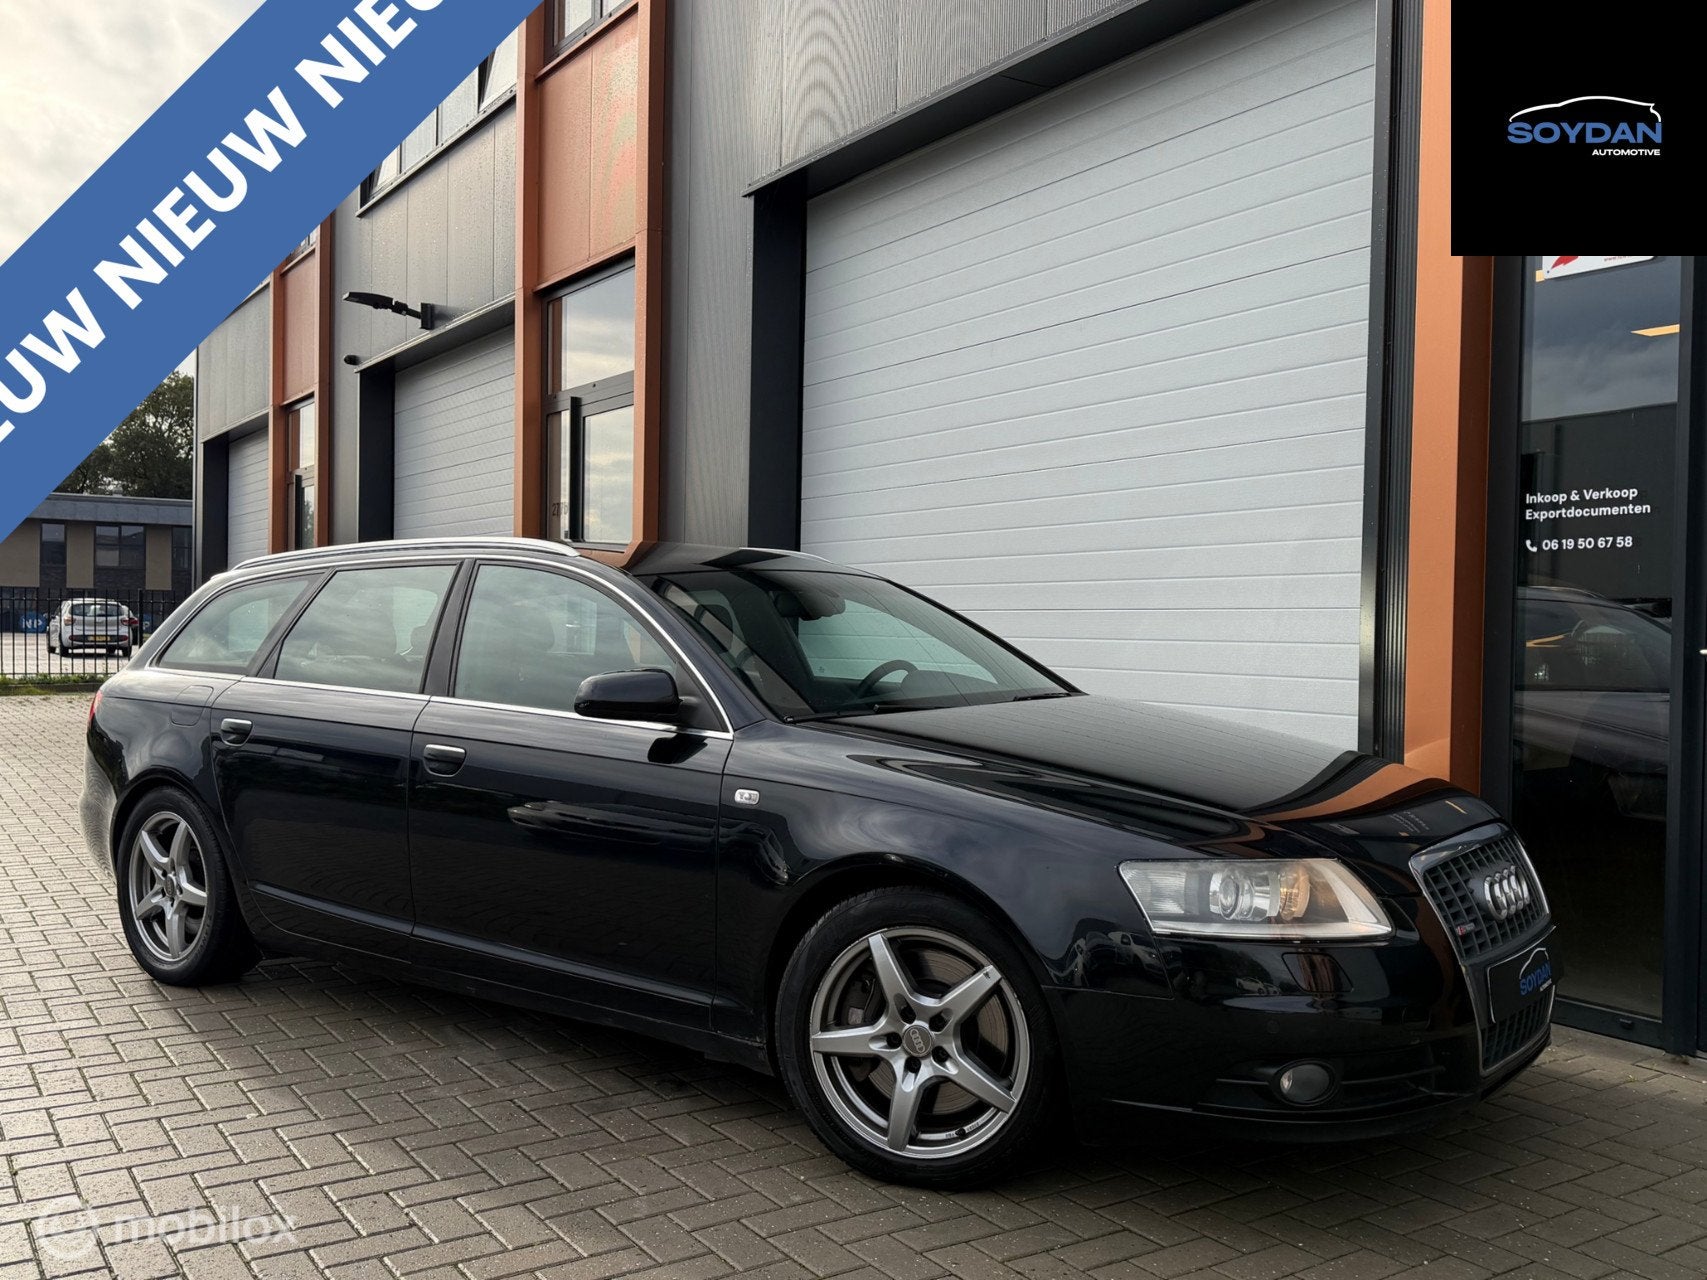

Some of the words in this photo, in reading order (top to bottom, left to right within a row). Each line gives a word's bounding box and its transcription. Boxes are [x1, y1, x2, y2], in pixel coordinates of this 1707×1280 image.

[1525, 492, 1567, 504] Inkoop
[1570, 490, 1580, 501] &
[1583, 487, 1638, 500] Verkoop
[1525, 504, 1650, 521] Exportdocumenten
[1542, 539, 1559, 550] 06
[1561, 539, 1575, 549] 19
[1577, 537, 1595, 549] 50
[1597, 536, 1613, 548] 67
[1616, 536, 1633, 547] 58
